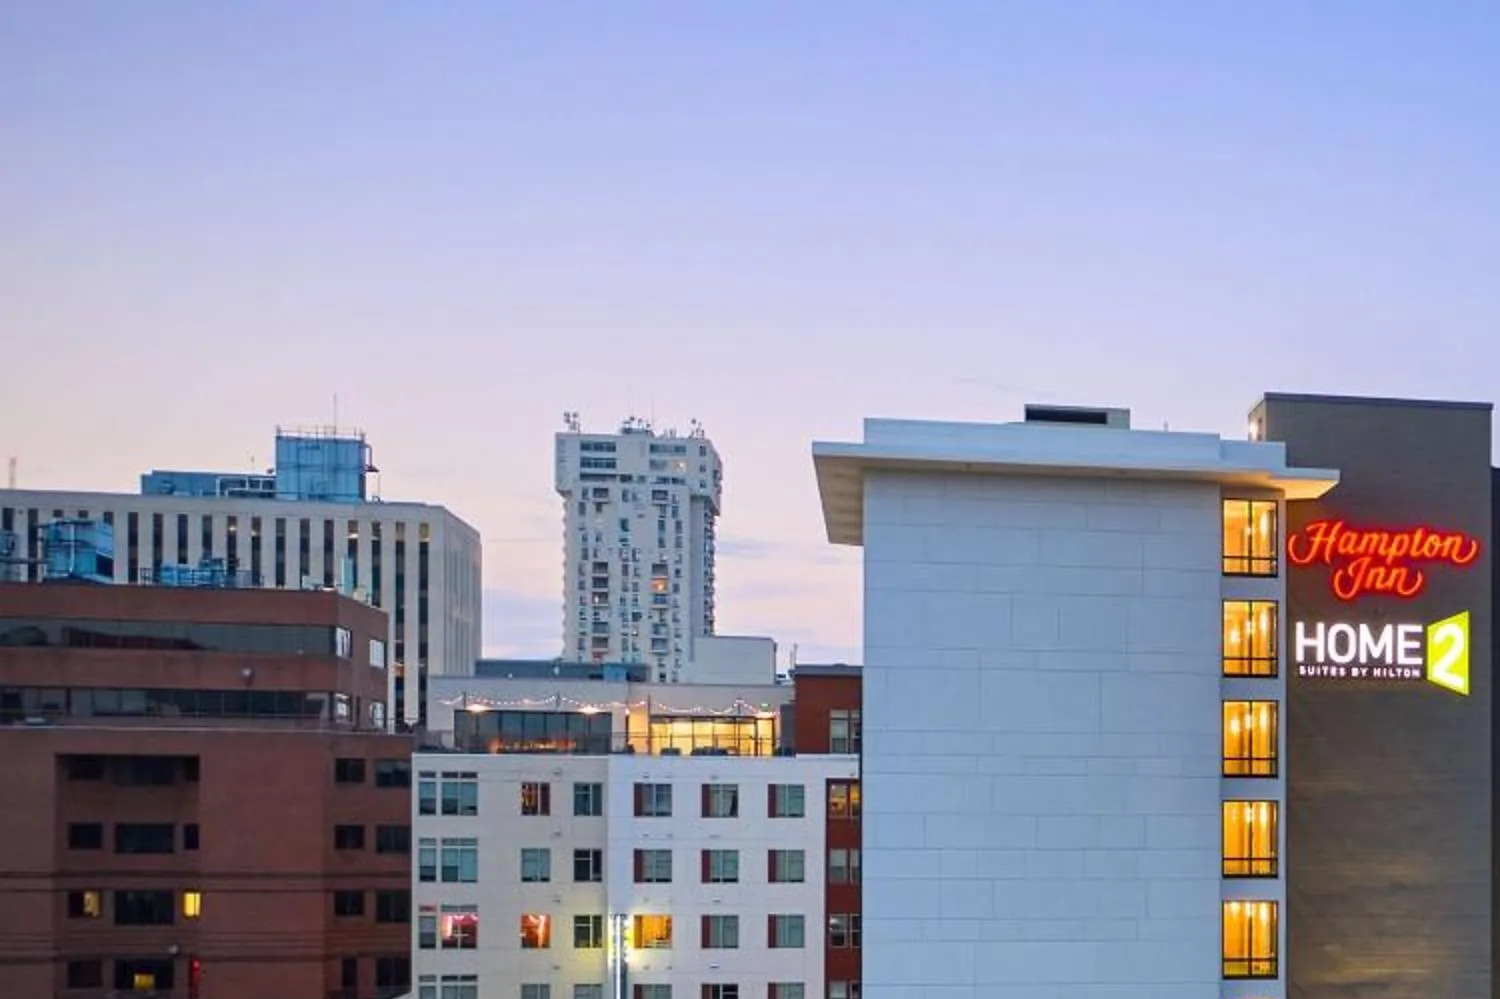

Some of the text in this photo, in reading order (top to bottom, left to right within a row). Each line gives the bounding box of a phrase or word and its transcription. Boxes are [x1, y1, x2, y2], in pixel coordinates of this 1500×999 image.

[1287, 520, 1478, 565] Hampton
[1333, 556, 1424, 600] Inn
[1299, 665, 1421, 678] SUITES BY HILTON
